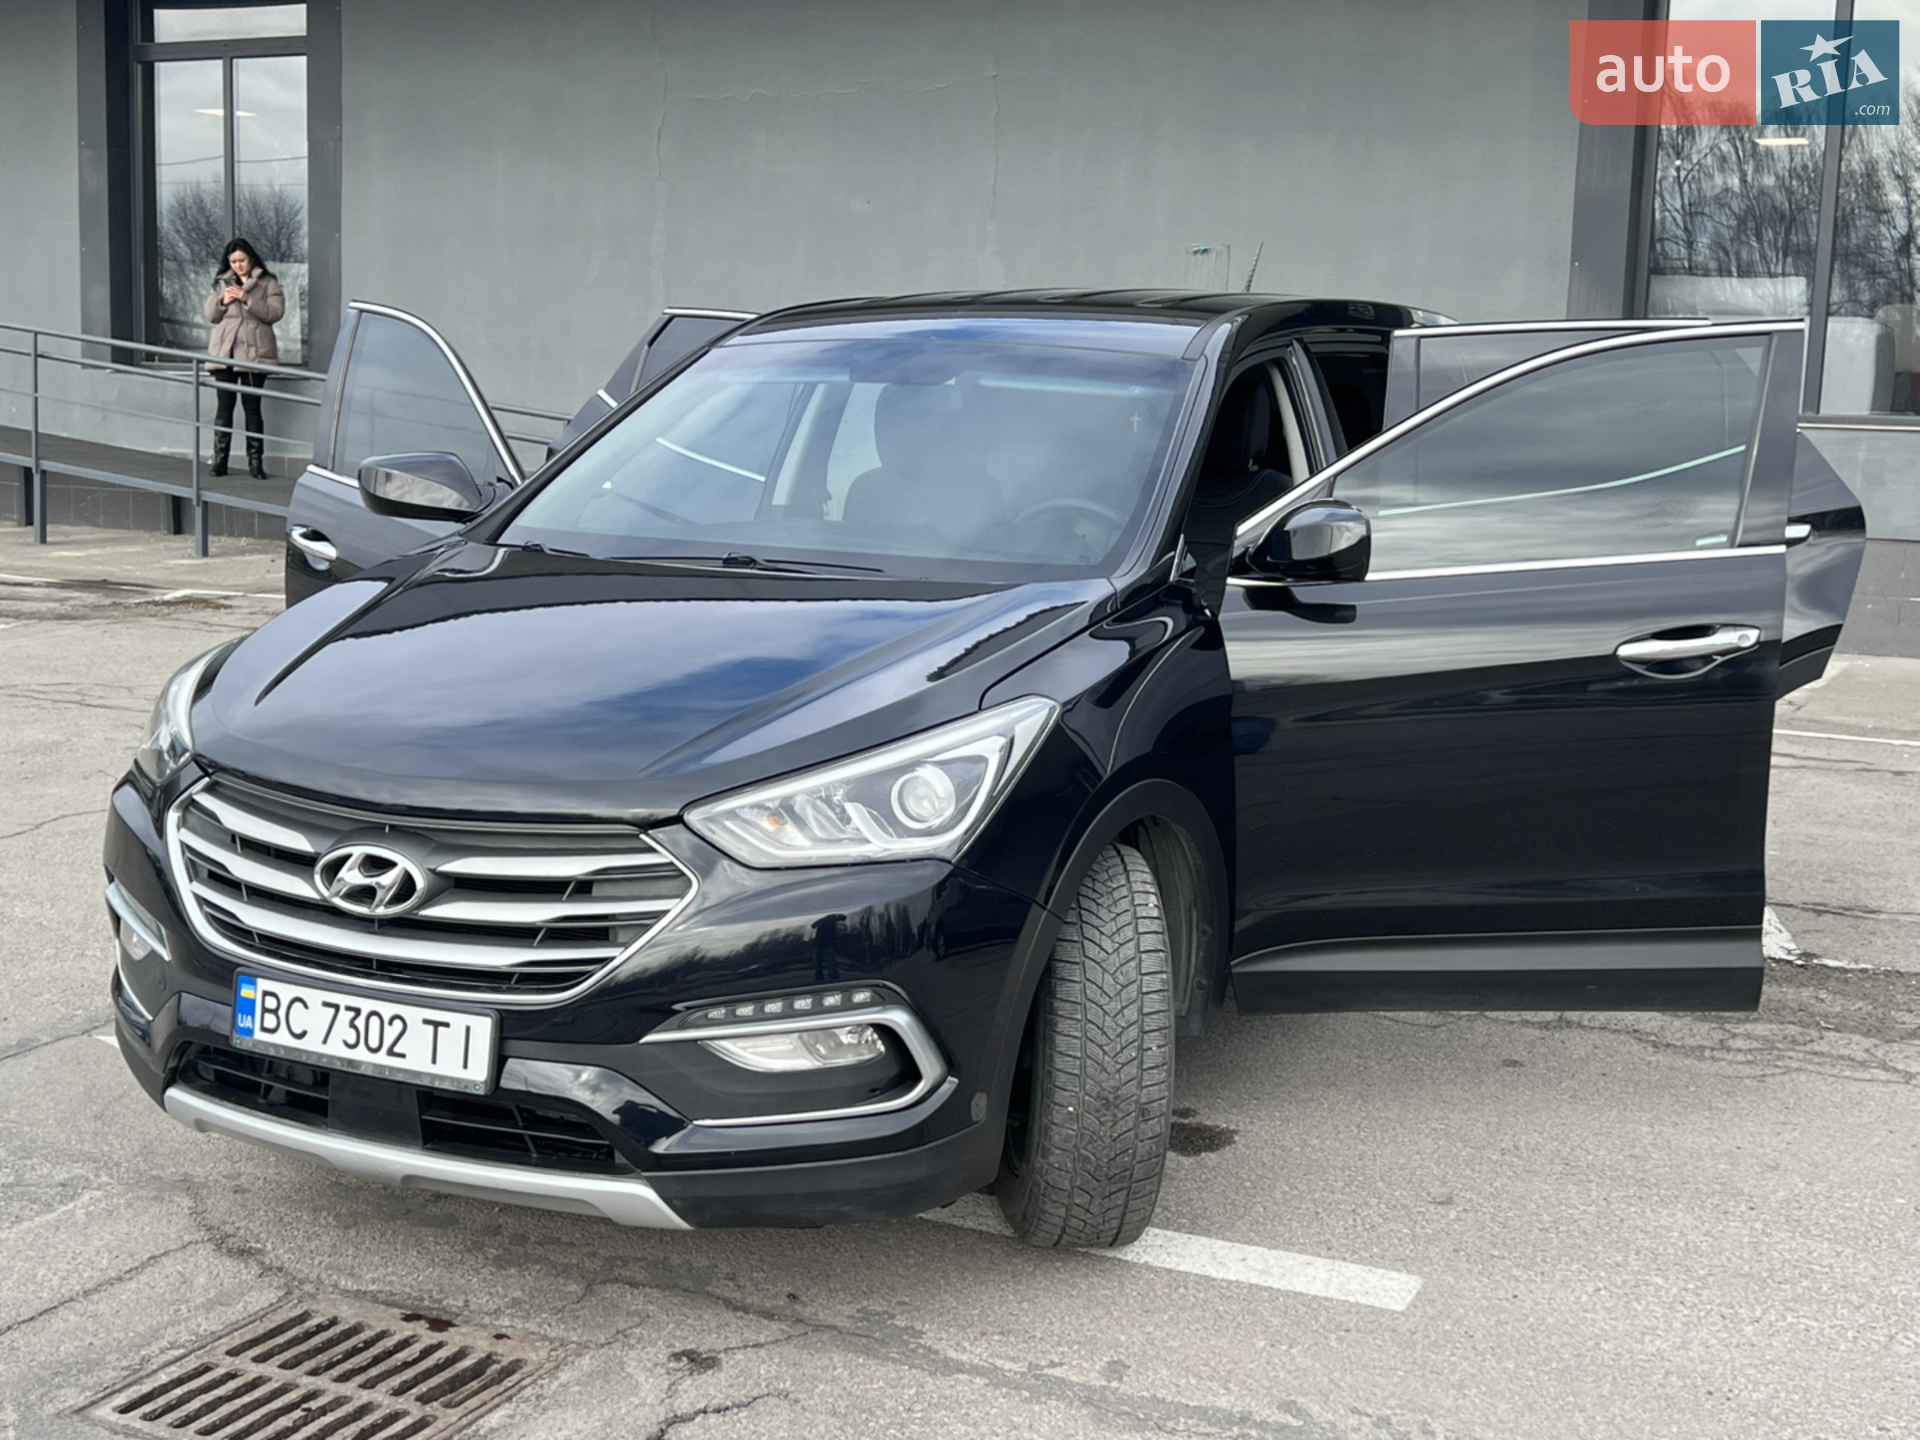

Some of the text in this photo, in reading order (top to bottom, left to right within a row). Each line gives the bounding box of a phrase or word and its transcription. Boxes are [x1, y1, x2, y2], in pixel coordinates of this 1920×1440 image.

[237, 1012, 253, 1030] UA
[259, 989, 472, 1070] BC 7302 TI
